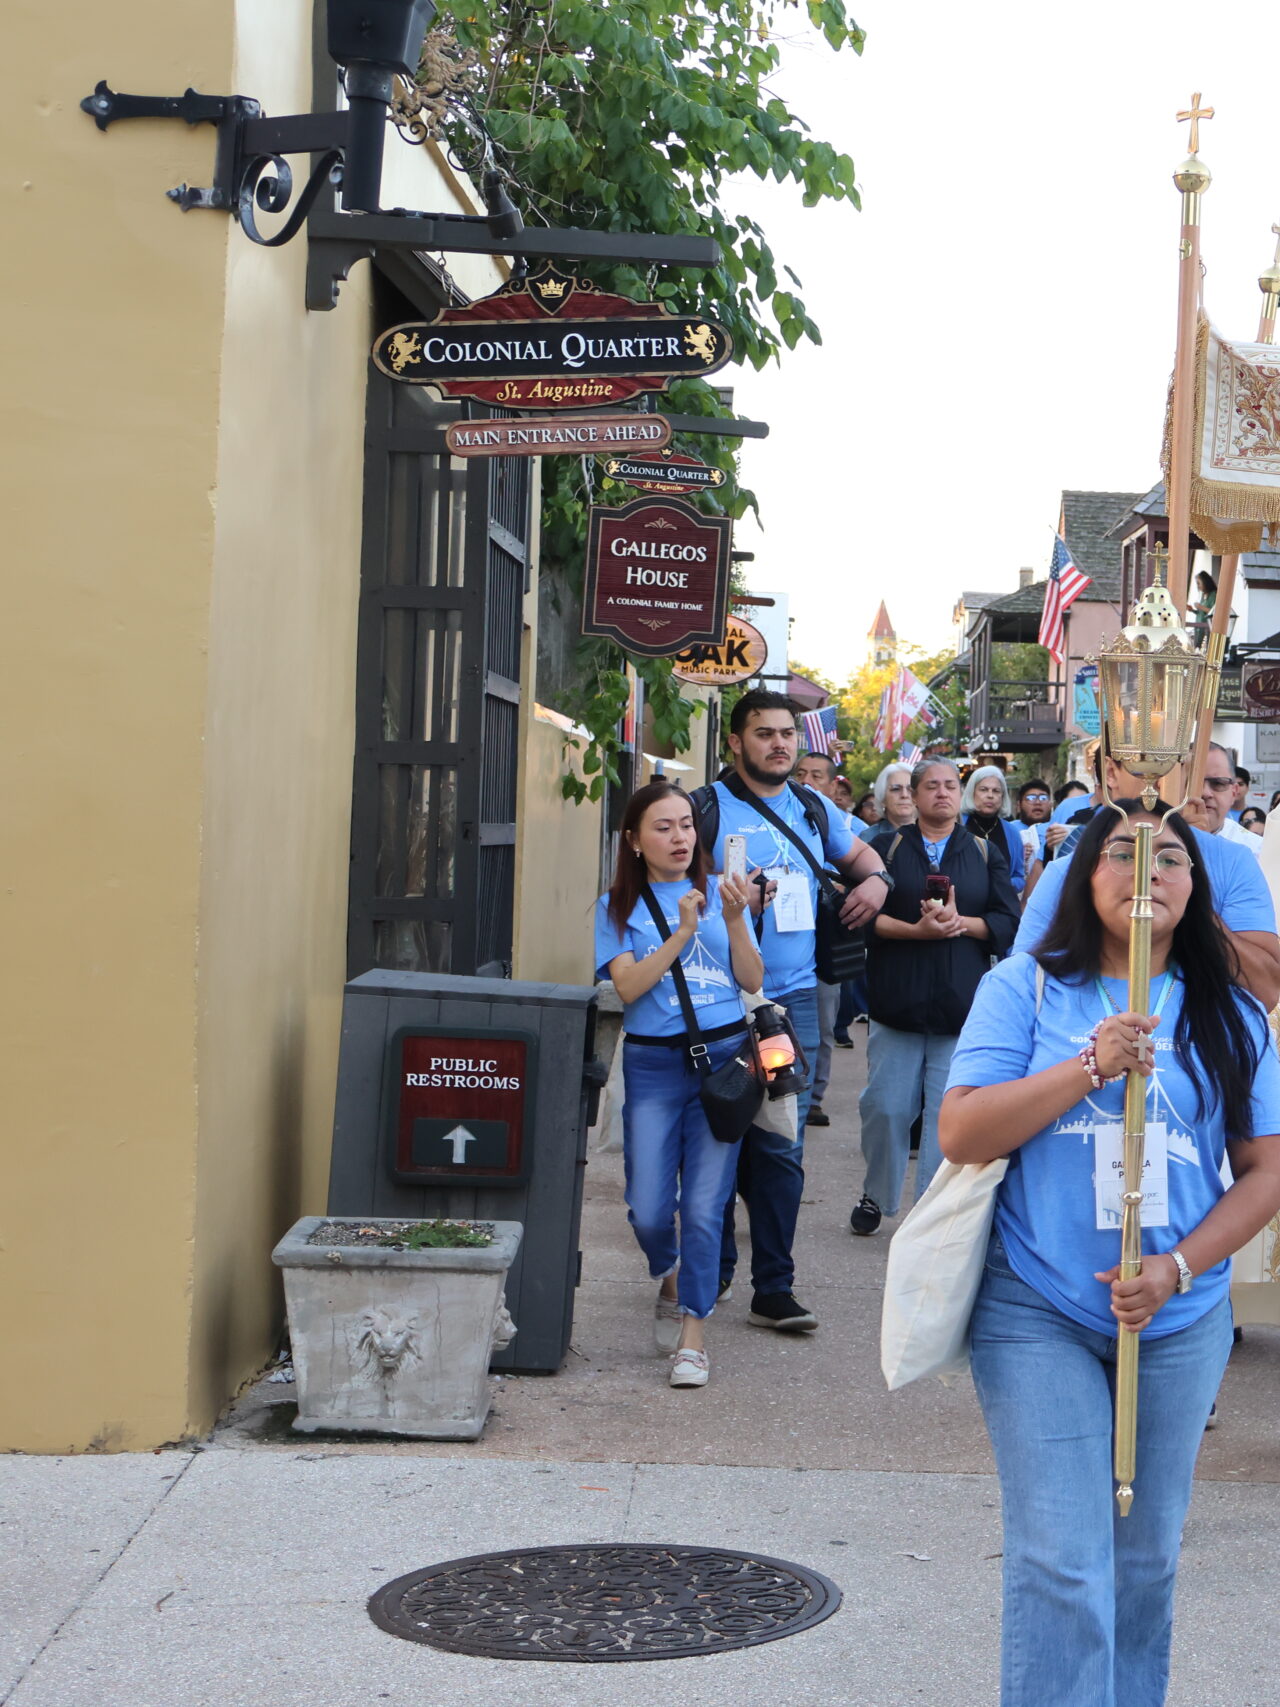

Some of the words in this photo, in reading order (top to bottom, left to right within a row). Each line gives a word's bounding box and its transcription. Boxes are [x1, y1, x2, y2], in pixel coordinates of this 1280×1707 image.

[423, 337, 553, 363] COLONIAL
[561, 332, 682, 367] QUARTER
[496, 381, 523, 402] St.
[527, 379, 613, 402] Augustine
[455, 431, 501, 447] MAIN
[507, 427, 598, 445] ENTRANCE
[602, 425, 662, 441] AHEAD
[620, 463, 665, 477] COLONIAL
[667, 467, 710, 480] QUARTER
[643, 481, 653, 489] St.
[653, 482, 685, 491] Augustine
[611, 537, 707, 562] GALLEGOS
[625, 566, 689, 588] HOUSE
[607, 596, 615, 605] A
[616, 597, 653, 607] COLONIAL
[654, 600, 680, 609] FAMILY
[681, 602, 704, 611] HOME
[681, 666, 710, 675] MUSIC
[713, 667, 737, 676] PARK
[430, 1057, 497, 1073] PUBLIC
[406, 1073, 520, 1090] RESTROOMS
